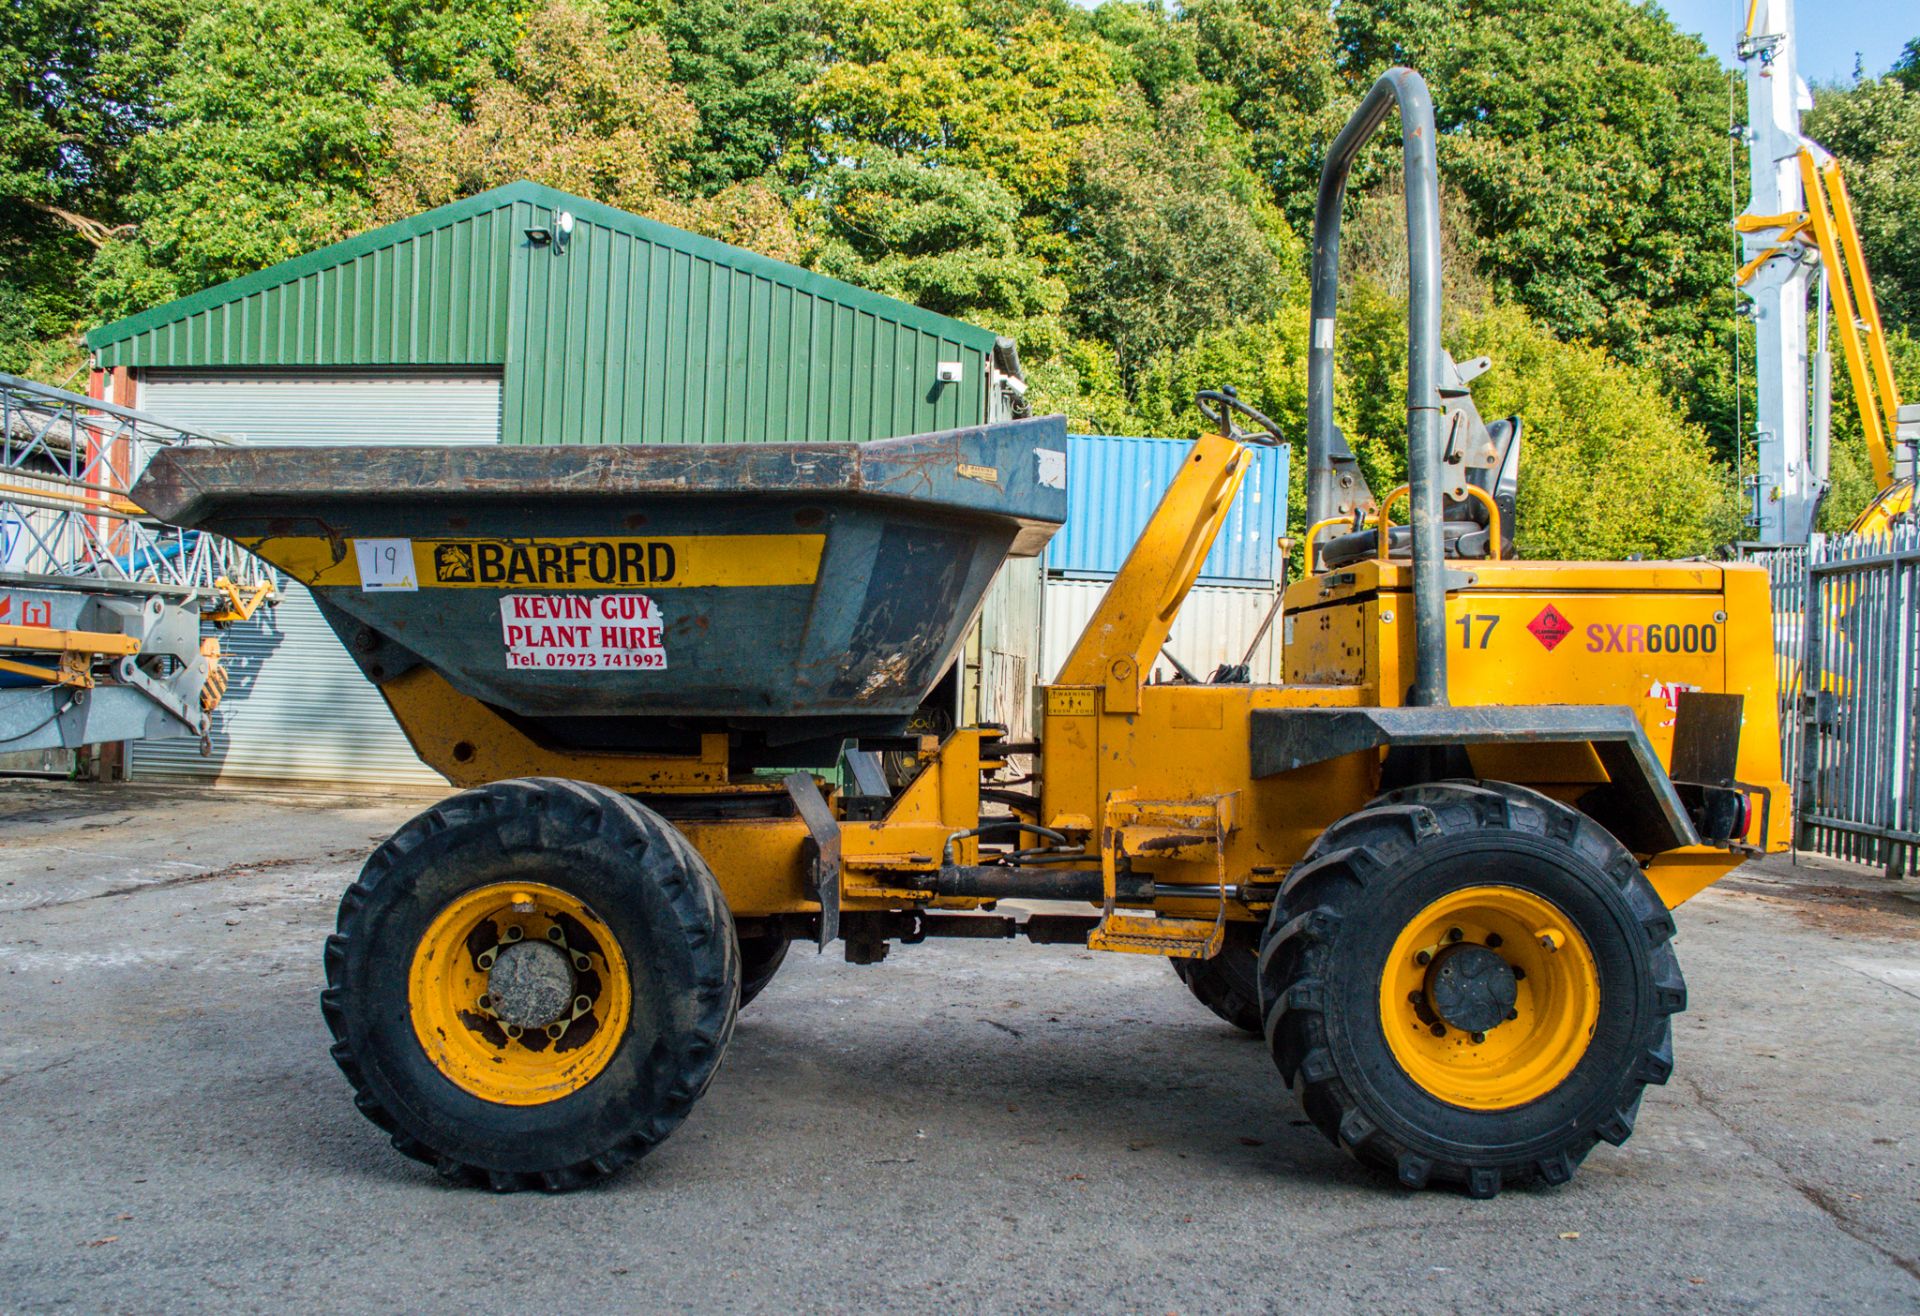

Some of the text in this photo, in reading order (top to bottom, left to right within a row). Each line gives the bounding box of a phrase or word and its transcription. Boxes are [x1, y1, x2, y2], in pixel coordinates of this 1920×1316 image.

[374, 546, 396, 575] 19
[477, 542, 676, 584] BARFORD
[512, 596, 651, 620] KEVIN GUY
[507, 625, 663, 649] PLANT HIRE
[1455, 613, 1501, 650] 17
[1586, 623, 1718, 654] SXR6000
[511, 652, 664, 668] Tel. 07973 741992
